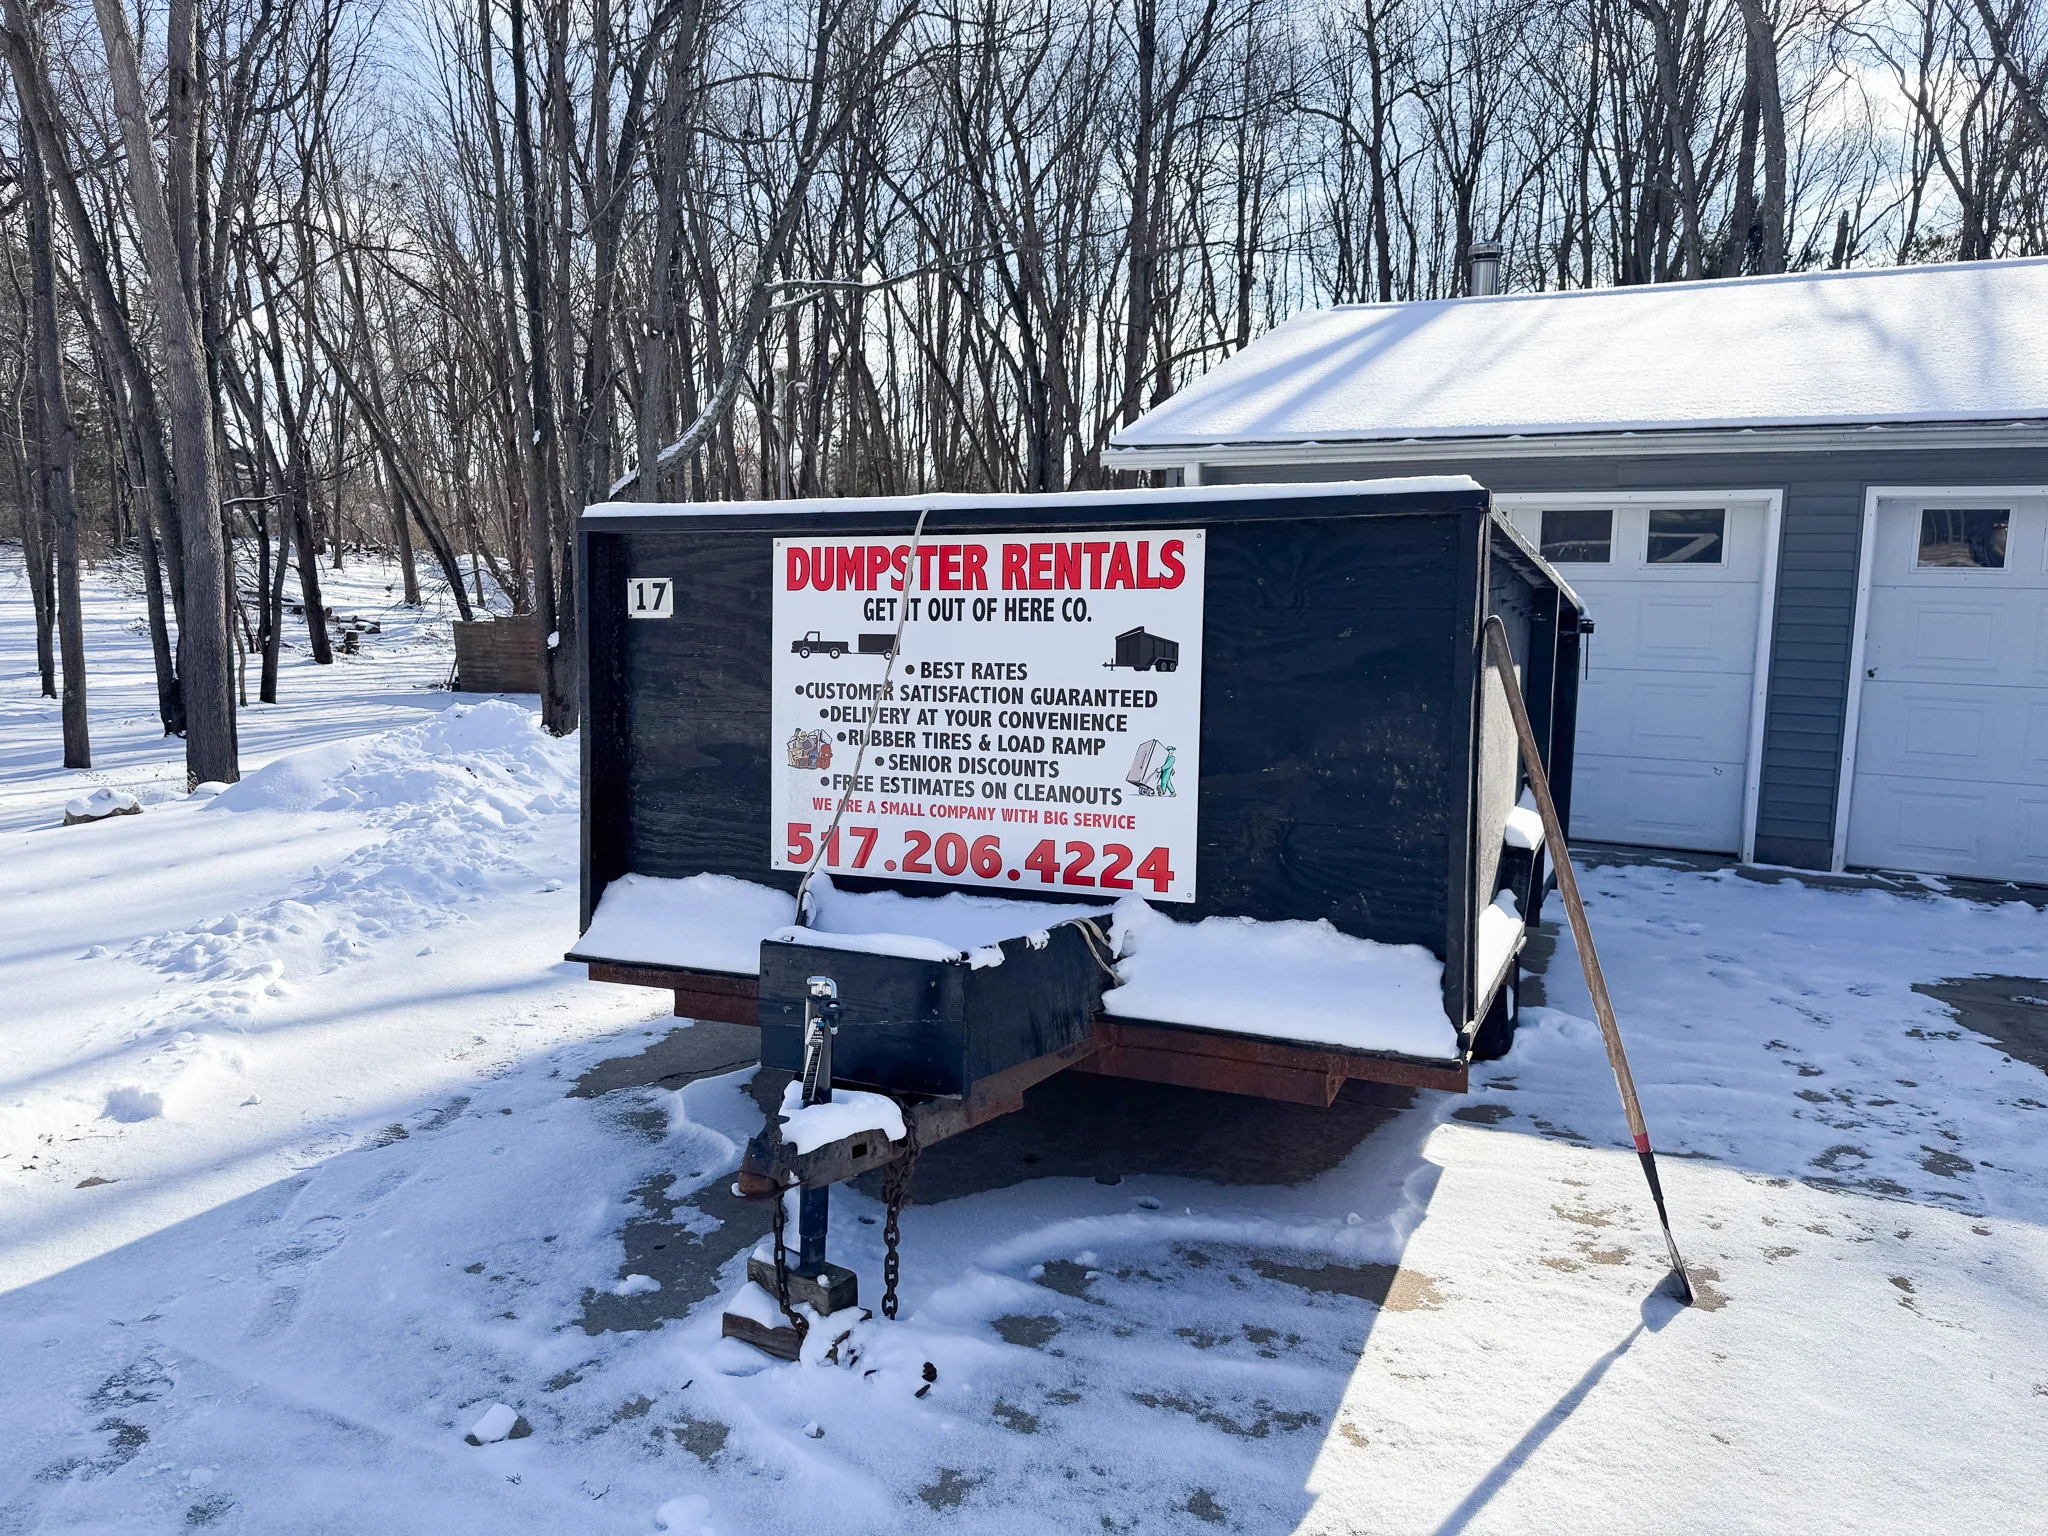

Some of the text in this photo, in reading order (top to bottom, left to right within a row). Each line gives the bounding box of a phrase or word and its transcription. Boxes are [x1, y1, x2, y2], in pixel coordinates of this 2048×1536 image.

[786, 539, 1186, 591] DUMPSTER RENTALS
[636, 582, 668, 610] 17
[863, 597, 1092, 622] GET IT OUT OF HERE CO.
[920, 661, 1028, 681] BEST RATES
[805, 682, 1158, 708] CUSTOMER SATISFACTION GUARANTEED
[830, 705, 1128, 733] DELIVERY AT YOUR CONVENIENCE
[848, 728, 1106, 756] RUBBER TIRES & LOAD RAMP
[888, 753, 1059, 779] SENIOR DISCOUNTS
[832, 774, 1122, 806] FREE ESTIMATES ON CLEANOUTS
[812, 797, 832, 811] WE
[867, 800, 876, 814] A
[880, 801, 925, 817] SMALL
[929, 803, 996, 821] COMPANY
[1001, 808, 1038, 824] WITH
[1043, 810, 1068, 826] BIG
[1073, 812, 1136, 830] SERVICE
[787, 822, 1175, 893] 517.206.4224
